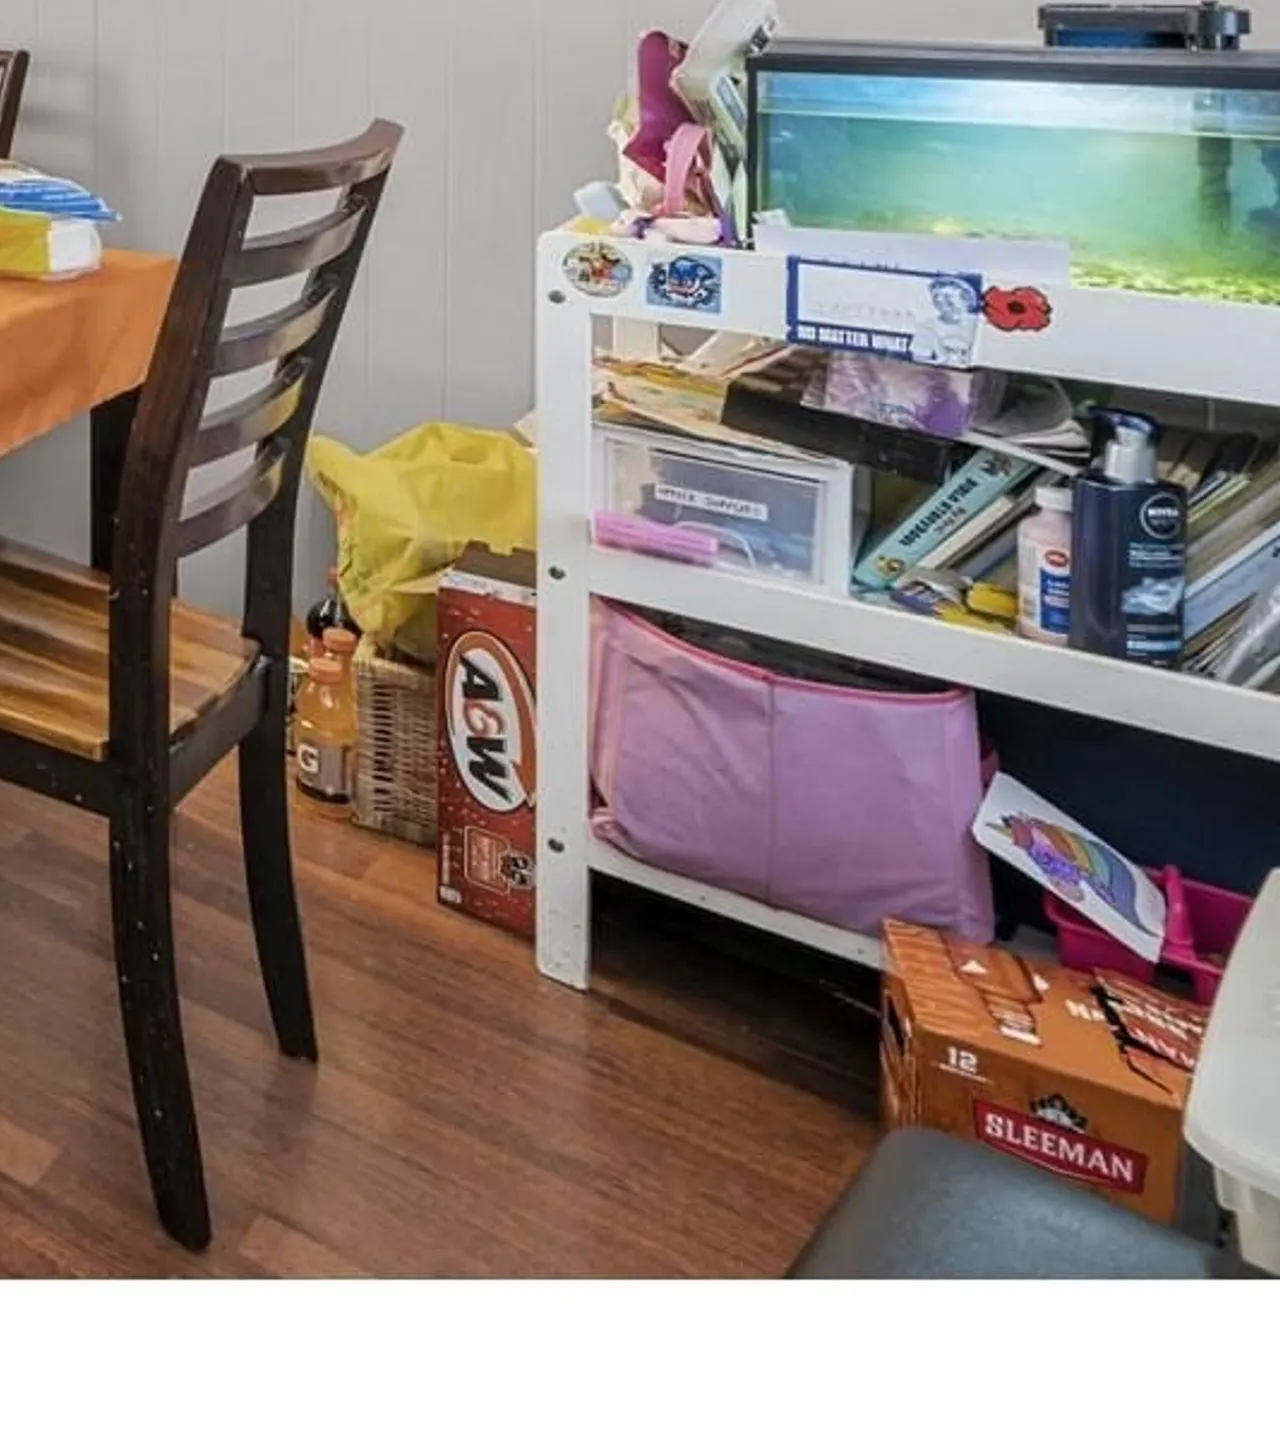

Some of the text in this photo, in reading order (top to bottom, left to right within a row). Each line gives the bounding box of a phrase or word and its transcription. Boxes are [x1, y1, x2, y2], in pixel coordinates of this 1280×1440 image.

[819, 328, 869, 347] MATTER
[871, 334, 909, 352] WHAT
[459, 653, 513, 805] A&W
[298, 743, 319, 774] G
[947, 1046, 977, 1073] 12
[984, 1113, 1135, 1184] SLEEMAN
